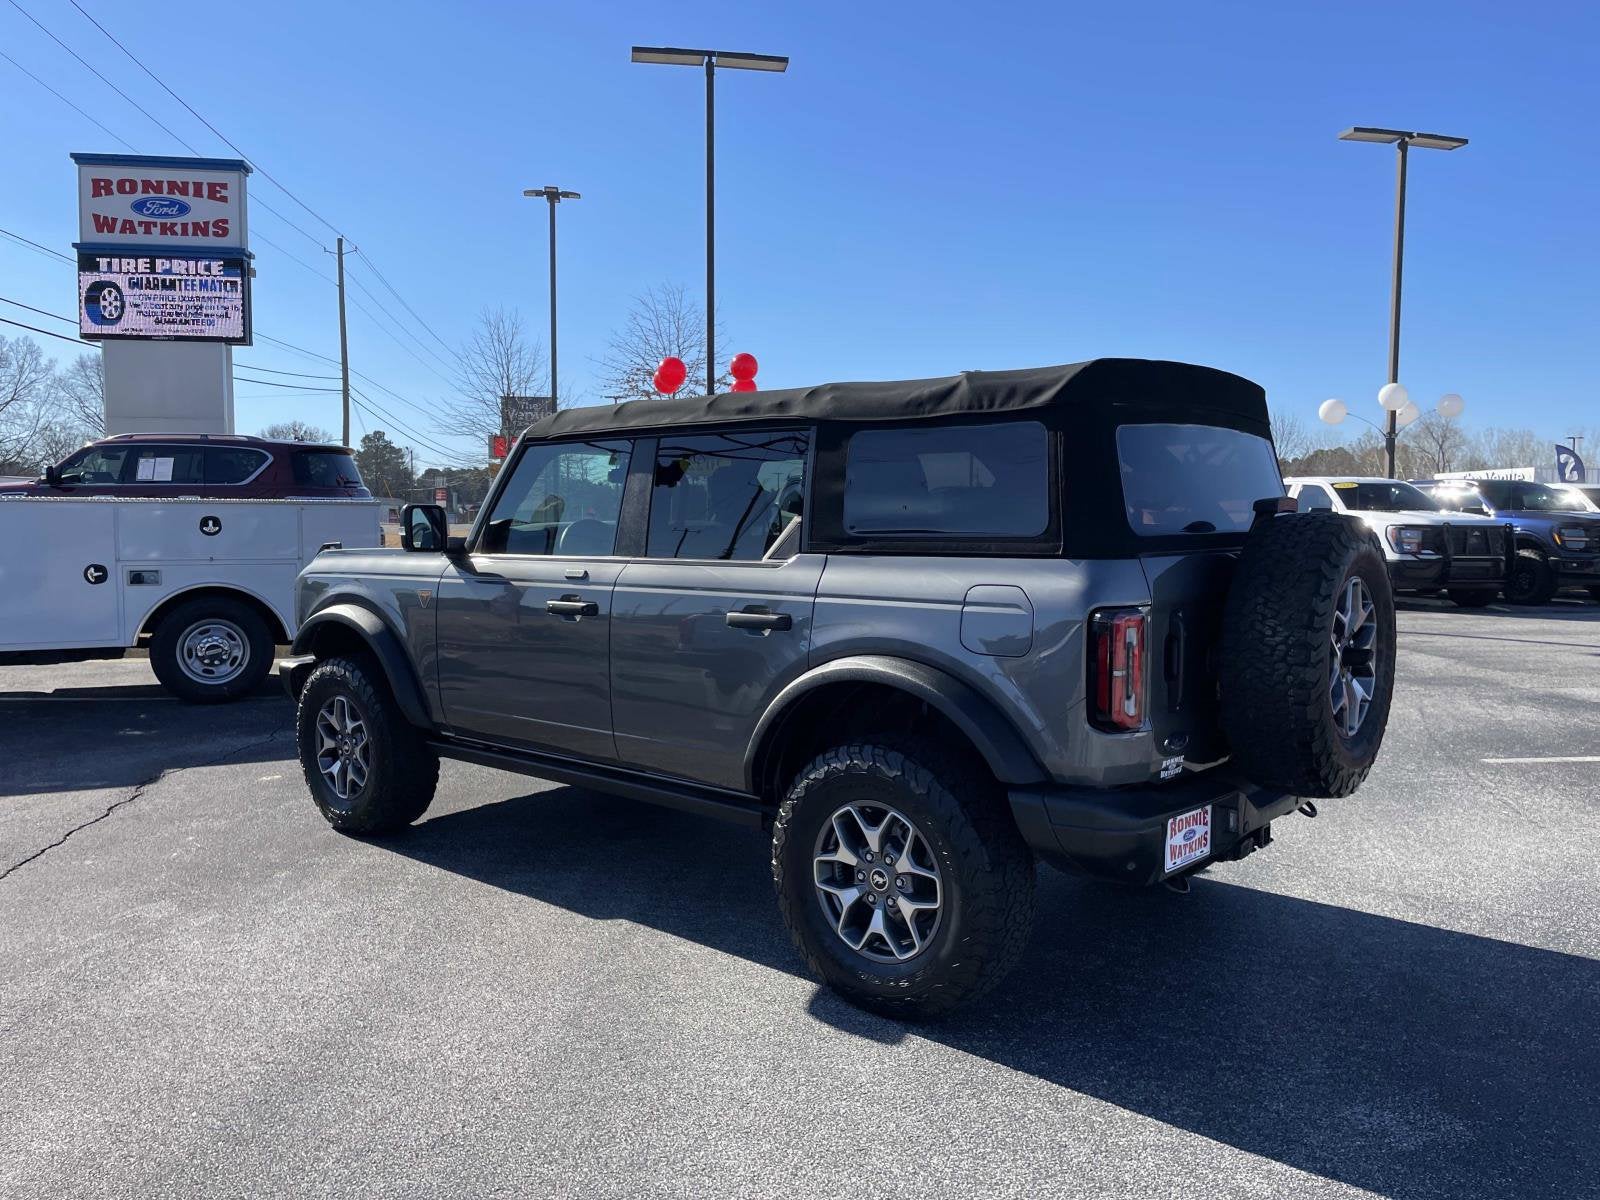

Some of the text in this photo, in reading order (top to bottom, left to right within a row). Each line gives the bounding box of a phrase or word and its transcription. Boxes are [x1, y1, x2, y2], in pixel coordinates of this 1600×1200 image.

[91, 178, 229, 203] RONNIE
[143, 201, 180, 215] Ford
[91, 213, 229, 238] WATKINS
[96, 257, 224, 275] TIRE PRICE
[128, 277, 239, 292] GUARANTEE MATCH
[1169, 809, 1209, 840] RONNIE
[1169, 831, 1209, 862] WATKINS
